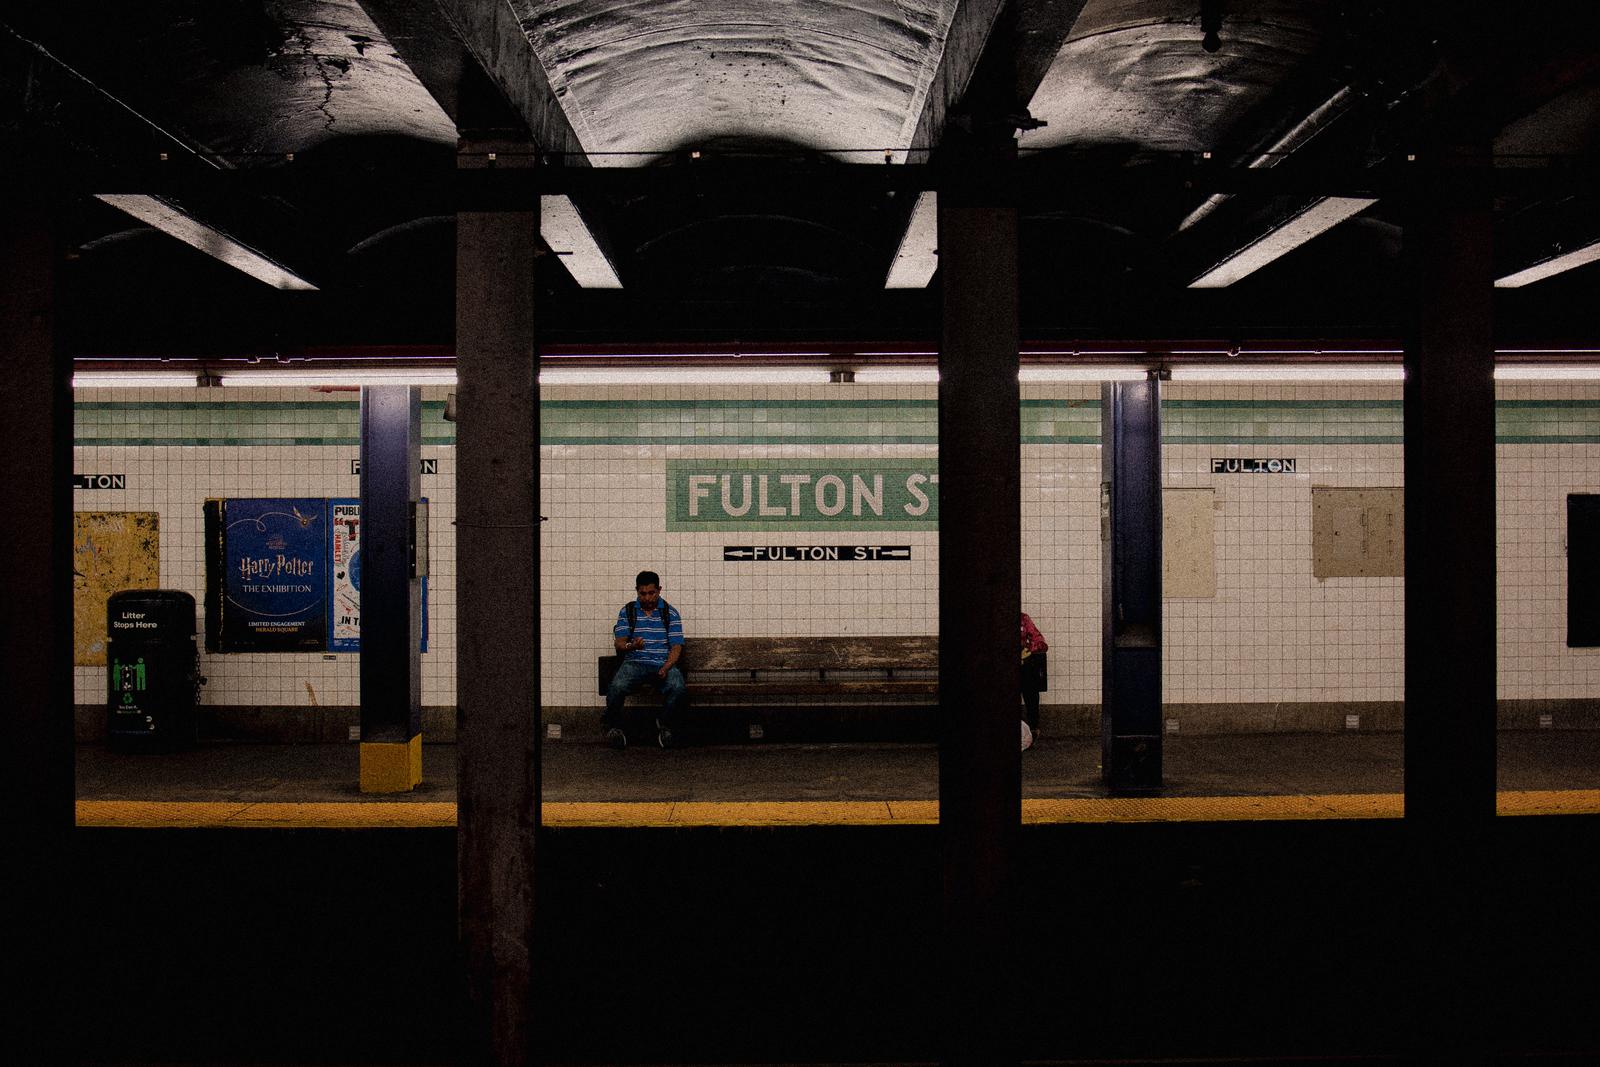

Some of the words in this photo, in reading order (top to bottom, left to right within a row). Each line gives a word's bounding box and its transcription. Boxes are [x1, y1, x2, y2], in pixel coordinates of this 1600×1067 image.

[1212, 459, 1295, 473] FULTON
[688, 474, 883, 517] FULTON
[753, 546, 838, 561] FULTON
[854, 546, 882, 561] ST
[239, 557, 275, 580] Harry
[276, 554, 314, 577] Potter
[243, 585, 261, 593] THE
[261, 585, 312, 593] EXHIBITION
[113, 621, 135, 629] Stops
[135, 621, 158, 629] Here
[341, 615, 351, 625] IN
